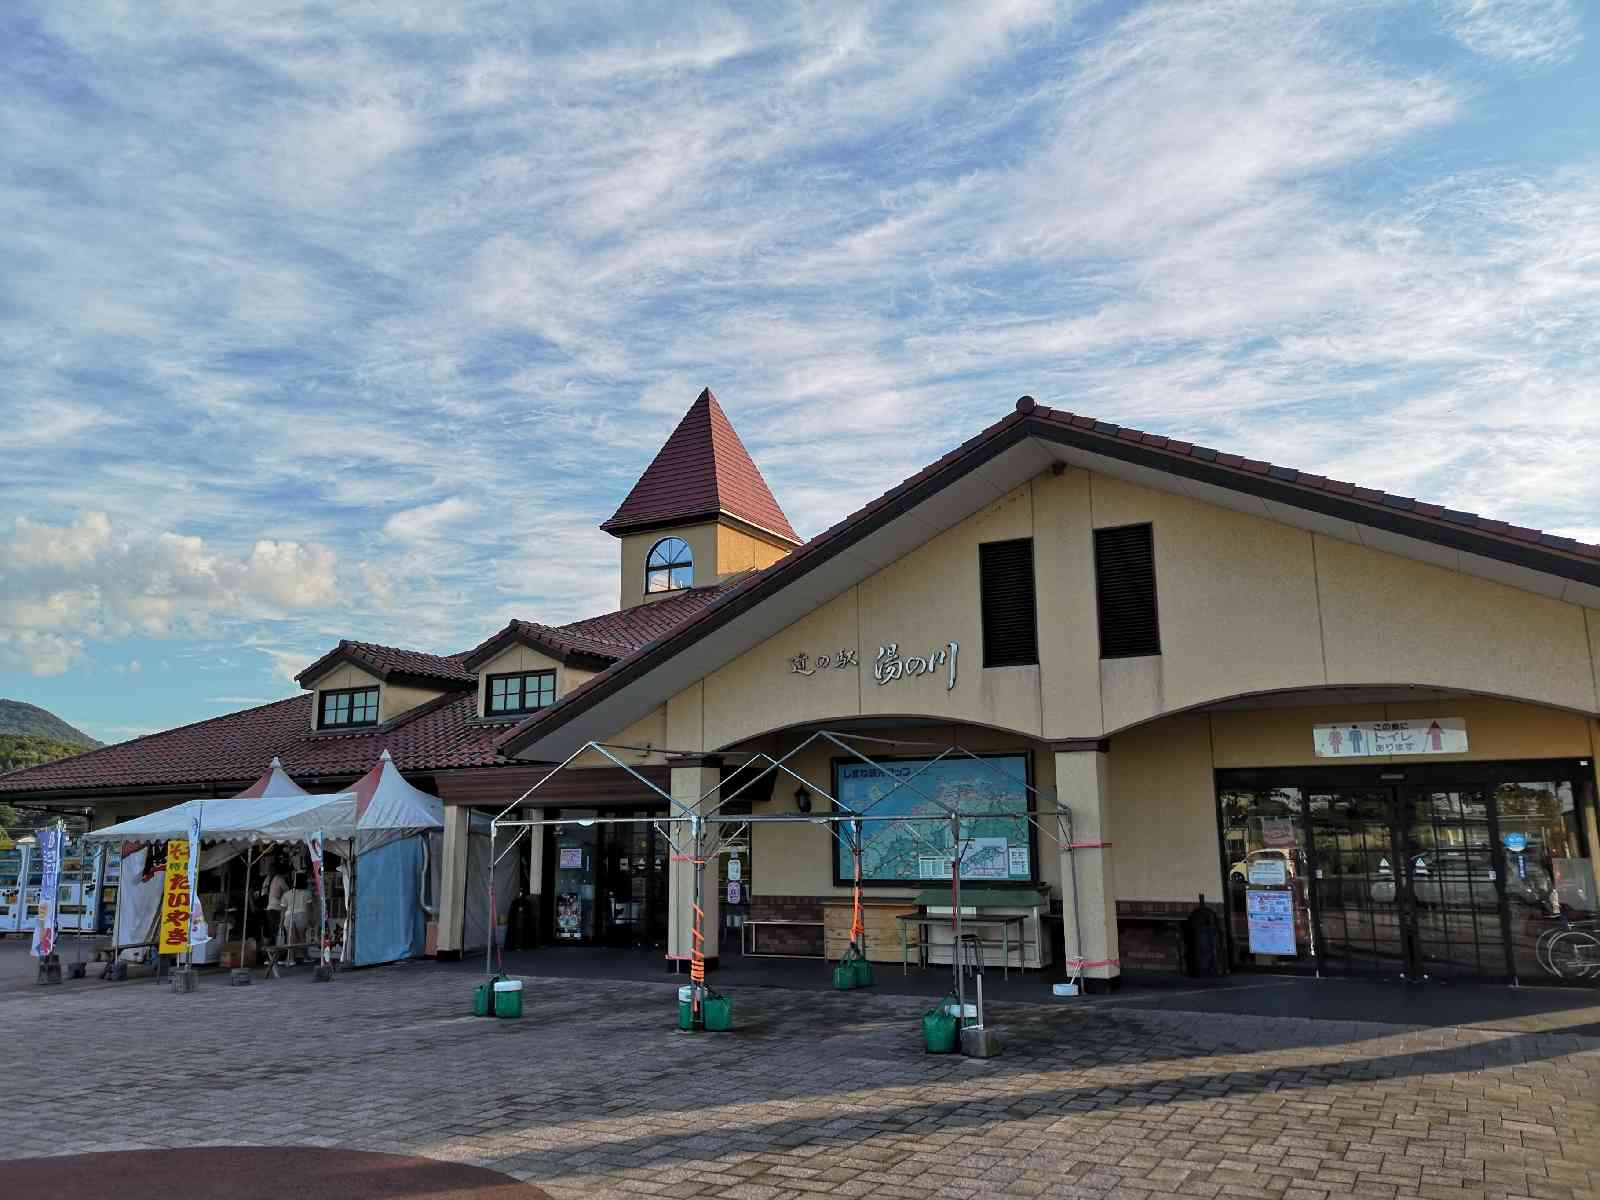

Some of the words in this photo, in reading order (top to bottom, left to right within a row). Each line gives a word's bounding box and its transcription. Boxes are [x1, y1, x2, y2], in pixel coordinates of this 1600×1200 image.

[791, 649, 859, 676] 道の駅
[875, 640, 959, 691] 湯の川
[1375, 732, 1413, 742] トイレ
[1375, 743, 1415, 752] あります
[165, 873, 190, 945] たいやき
